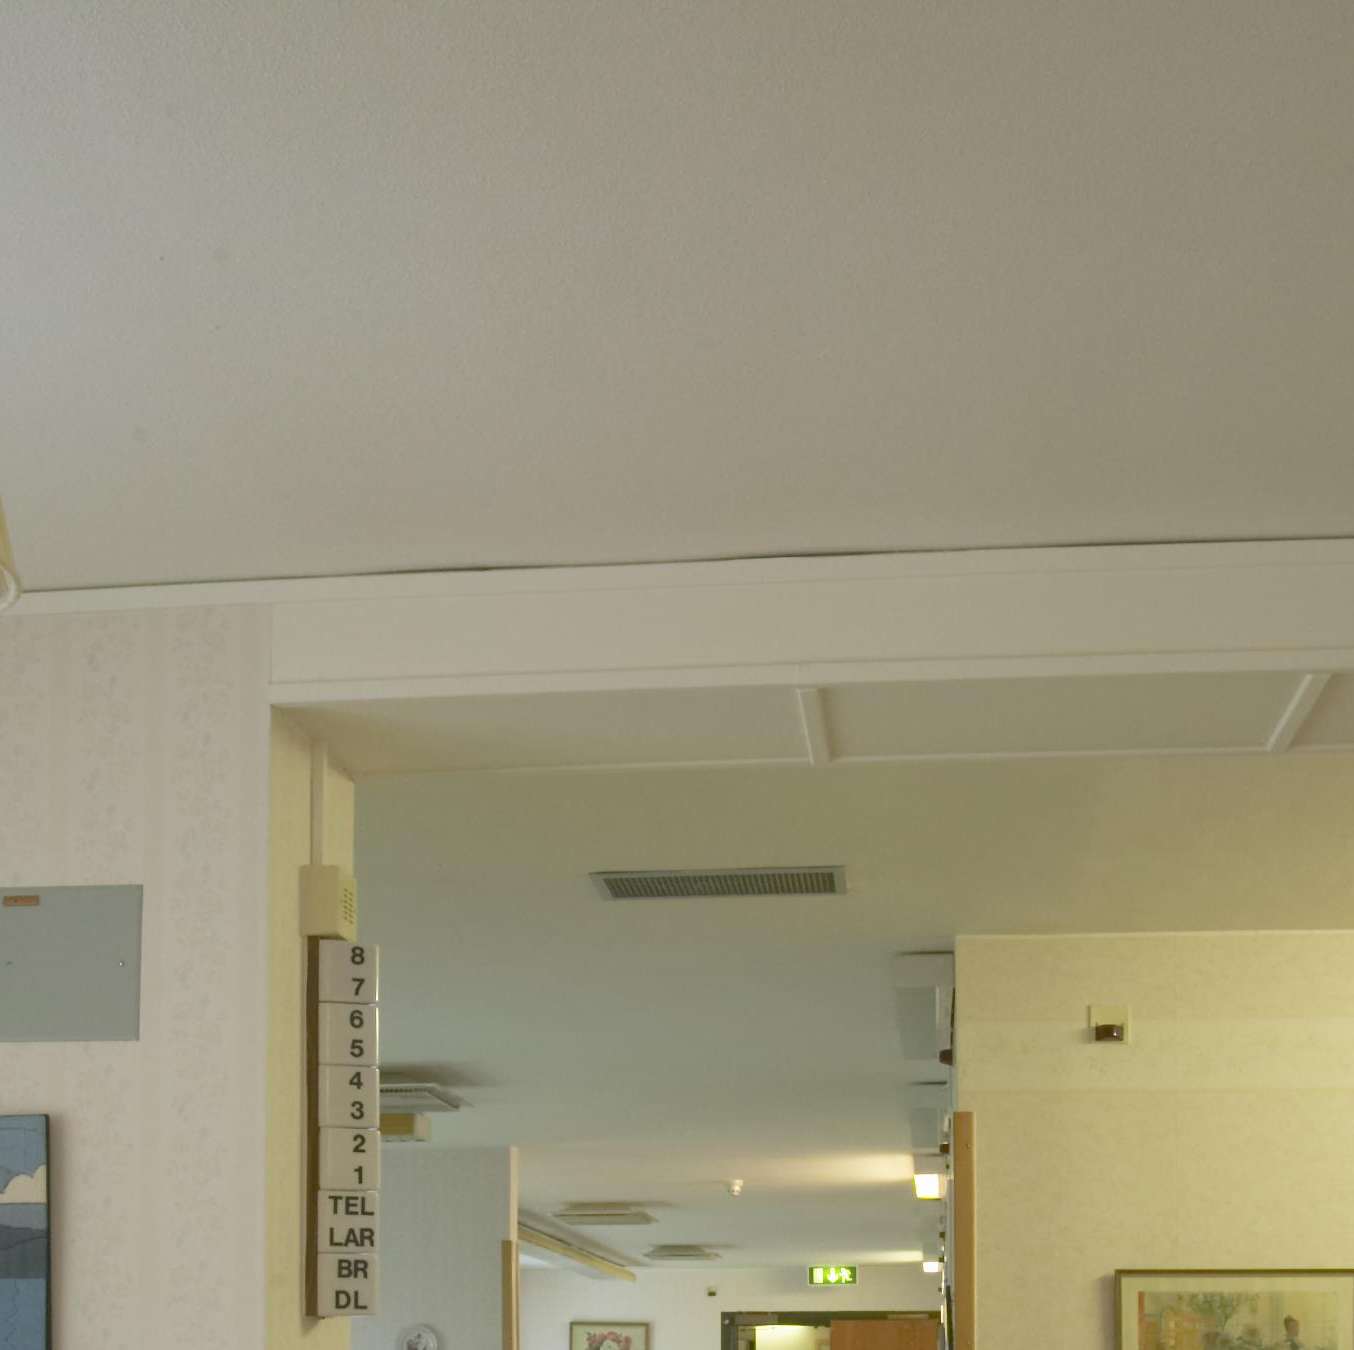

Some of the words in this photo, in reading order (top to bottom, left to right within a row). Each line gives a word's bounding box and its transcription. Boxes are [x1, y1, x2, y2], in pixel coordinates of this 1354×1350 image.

[350, 946, 365, 965] 8
[351, 977, 365, 996] 7
[349, 1009, 364, 1029] 6
[349, 1039, 364, 1058] 5
[349, 1071, 363, 1090] 4
[350, 1101, 364, 1120] 3
[352, 1134, 366, 1153] 2
[353, 1165, 363, 1184] 1
[328, 1195, 375, 1216] TEL
[329, 1227, 375, 1247] LAR
[337, 1259, 368, 1279] BR
[335, 1290, 368, 1310] DL
